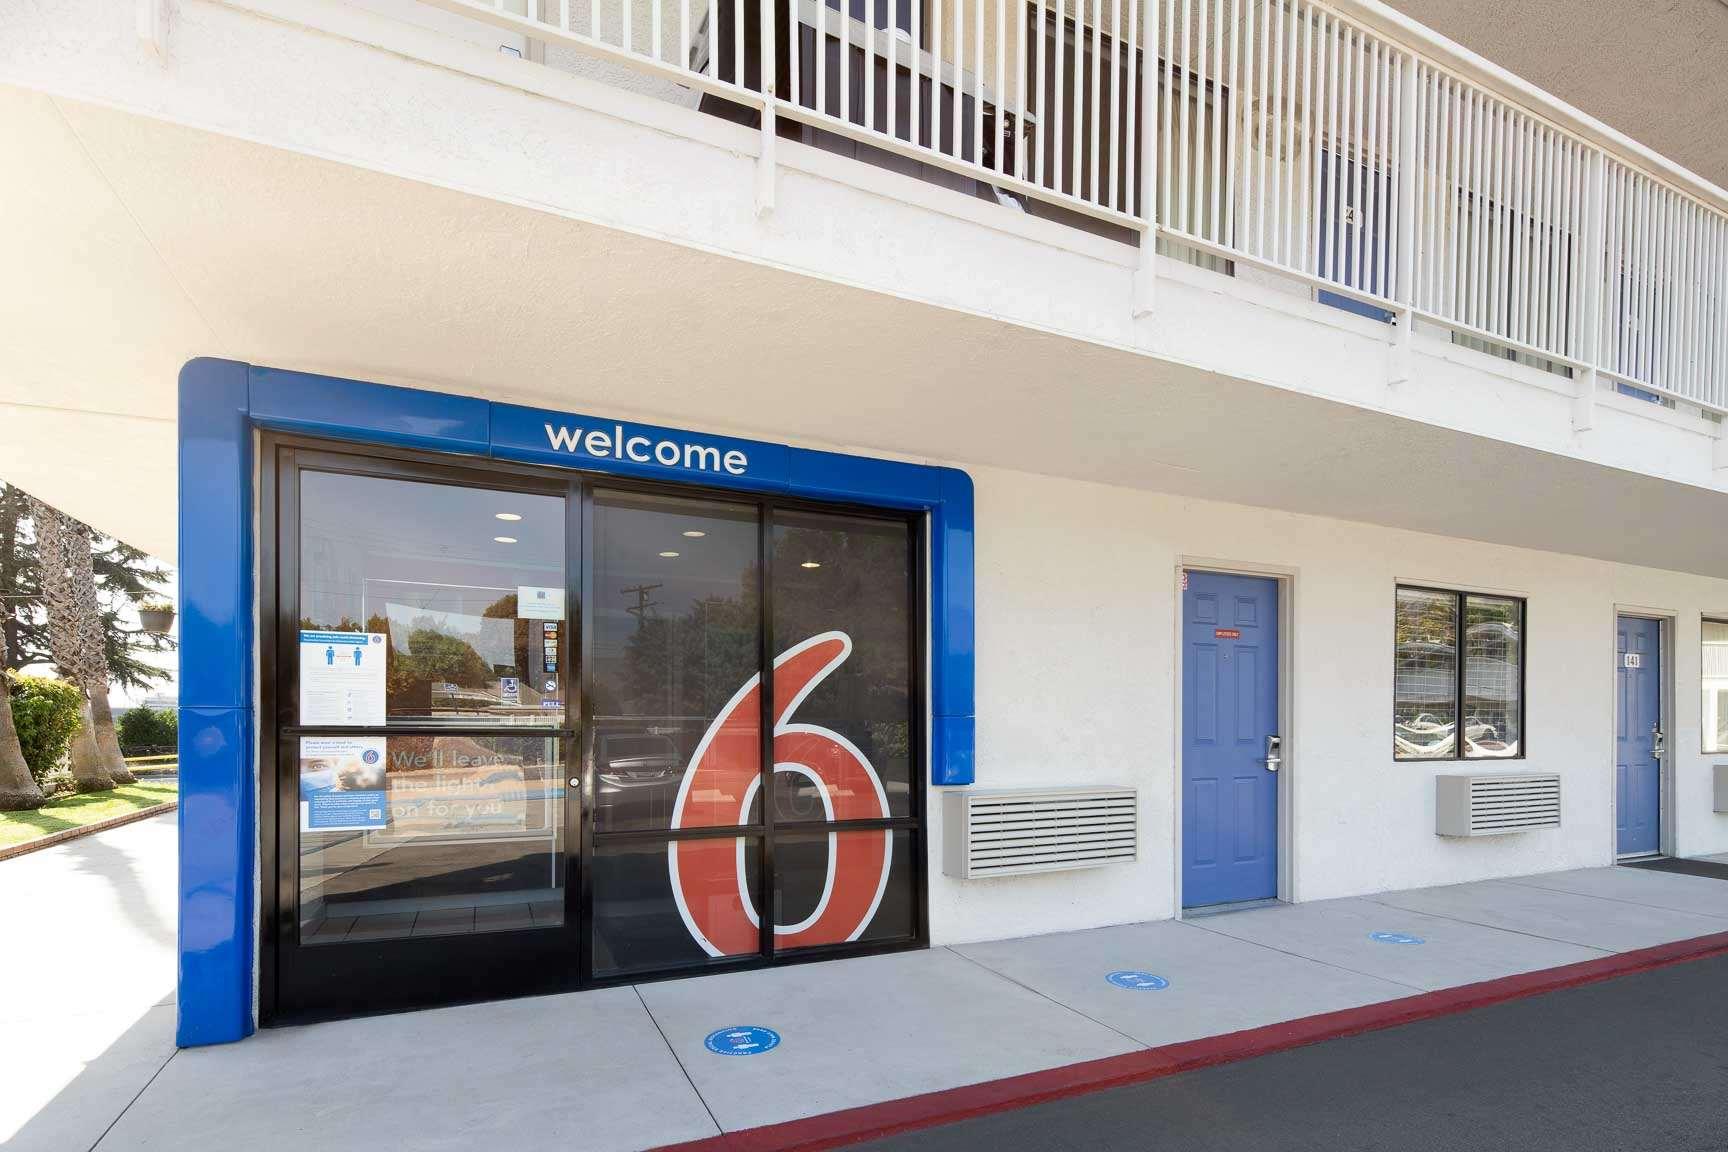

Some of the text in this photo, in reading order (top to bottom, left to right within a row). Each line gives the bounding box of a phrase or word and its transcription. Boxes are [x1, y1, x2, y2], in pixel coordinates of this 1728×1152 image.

[544, 423, 748, 475] welcome
[1626, 655, 1639, 666] 141
[391, 750, 504, 768] We'll leave
[393, 776, 427, 792] the
[668, 630, 893, 958] 6
[393, 800, 503, 820] on for you
